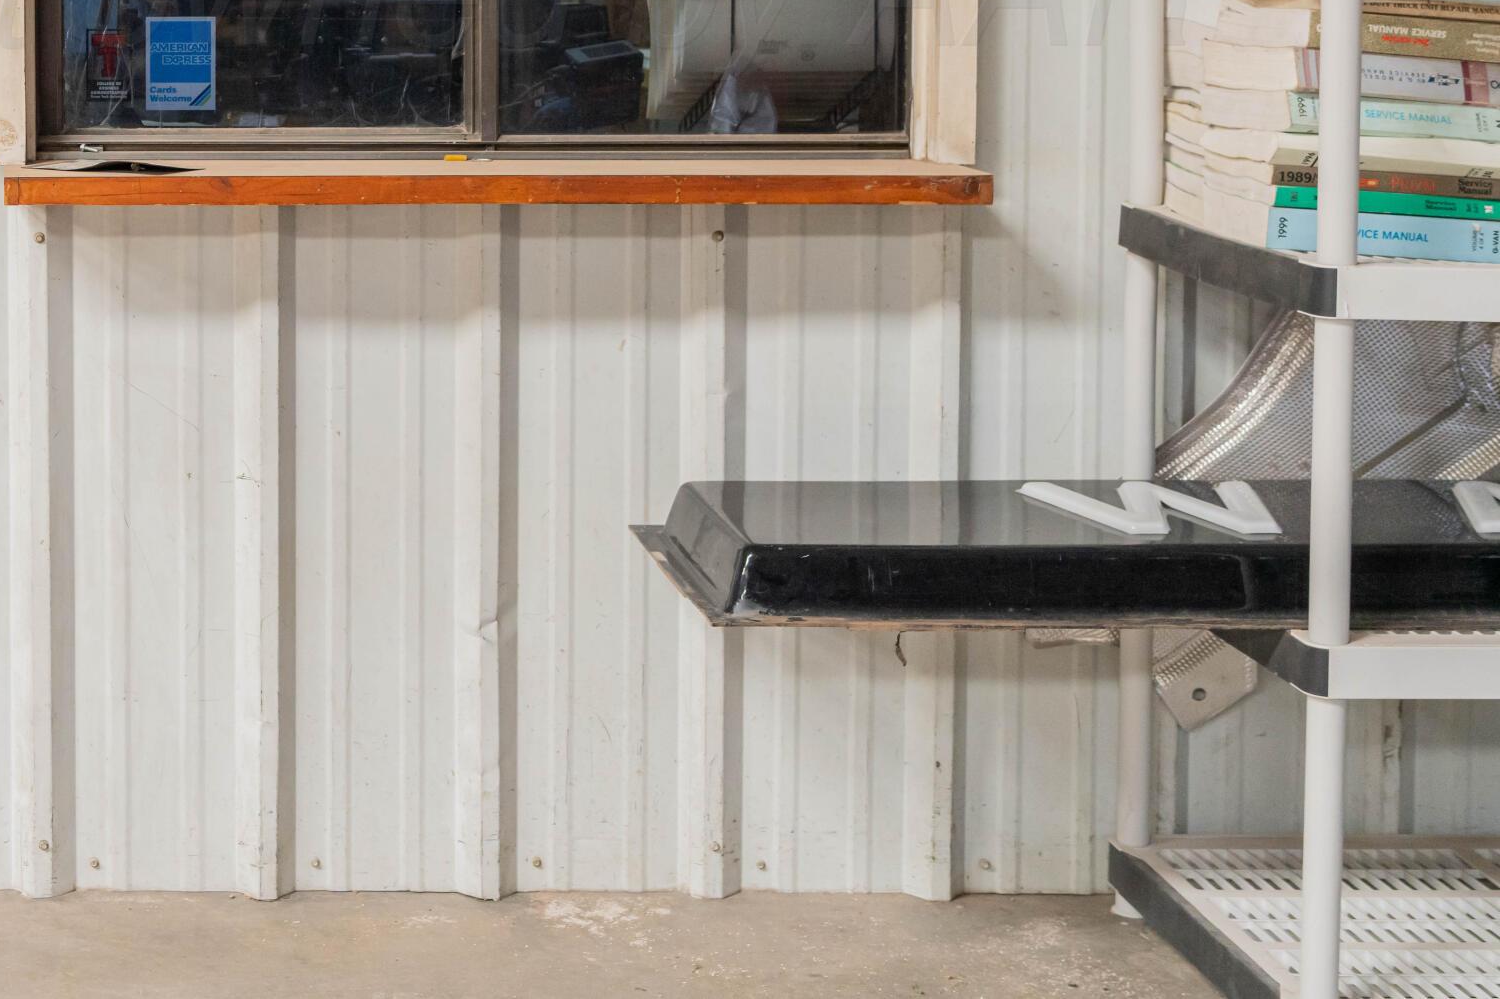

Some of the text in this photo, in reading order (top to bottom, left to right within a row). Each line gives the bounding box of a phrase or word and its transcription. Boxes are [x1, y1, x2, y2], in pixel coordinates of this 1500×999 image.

[1368, 24, 1447, 38] SERVICE MANUAL
[150, 42, 209, 53] AMERICAN
[162, 55, 211, 65] EXPRESS
[150, 86, 177, 94] Cards
[1297, 96, 1307, 117] 1999
[1364, 109, 1452, 124] SERVICE MANUAL
[1279, 171, 1317, 183] 1989/
[1278, 217, 1288, 238] 1999
[1382, 231, 1428, 242] MANUAL
